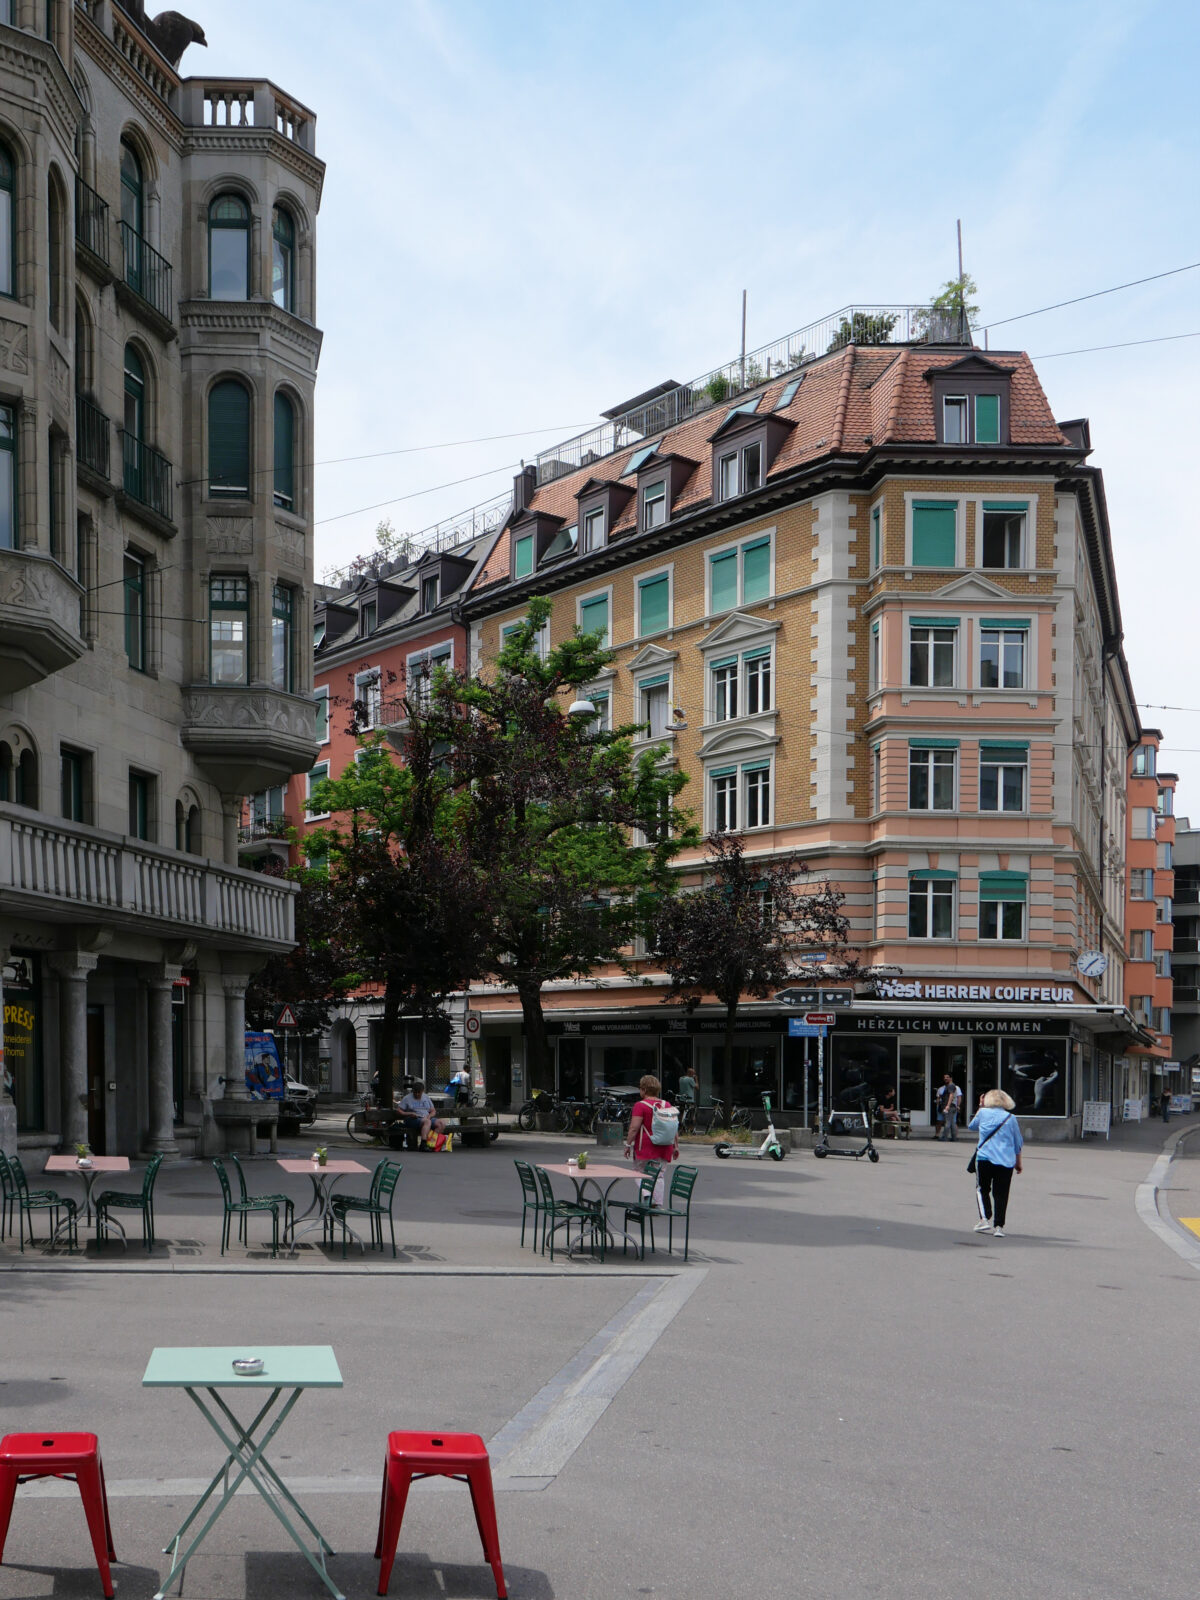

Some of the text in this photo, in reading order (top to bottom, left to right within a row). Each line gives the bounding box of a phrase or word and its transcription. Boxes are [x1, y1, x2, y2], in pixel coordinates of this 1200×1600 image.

[876, 979, 1074, 1001] West HERREN COIFFEUR
[3, 1005, 35, 1031] PRESS
[857, 1019, 1042, 1032] HERZLICH WILLKOMMEN
